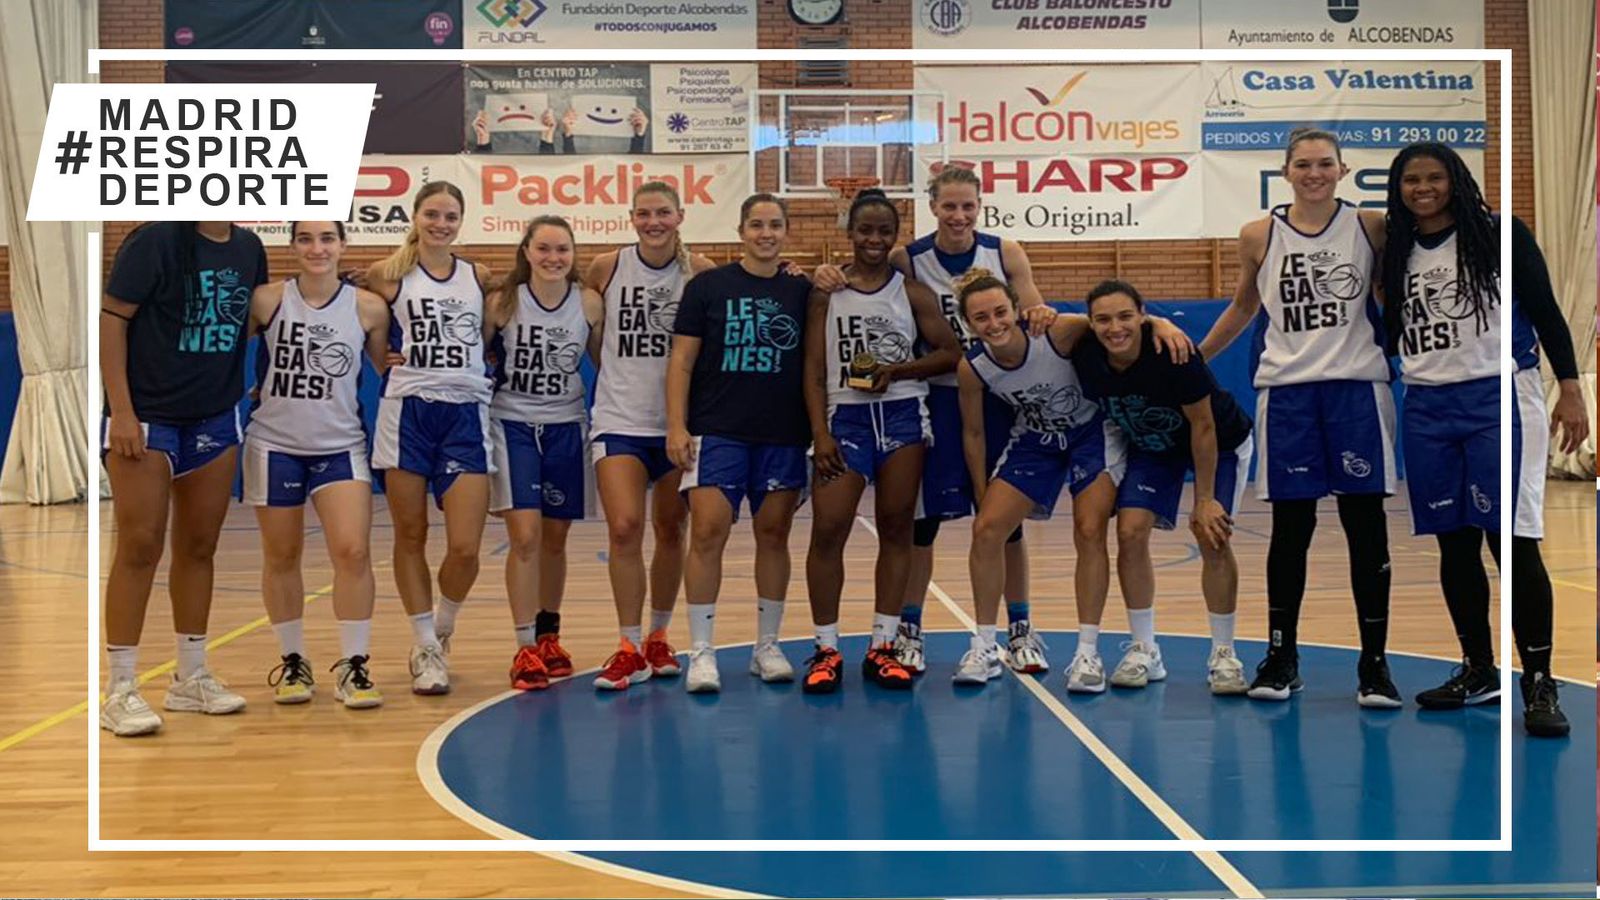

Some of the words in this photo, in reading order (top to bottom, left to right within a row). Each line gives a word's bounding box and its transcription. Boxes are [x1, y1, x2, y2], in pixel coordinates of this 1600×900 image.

[562, 3, 624, 15] Fundación
[625, 3, 677, 17] Deporte
[678, 3, 748, 15] Alcobendas
[992, 0, 1039, 10] CLUB
[1045, 0, 1172, 9] BALONCESTO
[1016, 15, 1148, 30] ALCOBENDAS
[478, 31, 546, 44] FUNDAL
[1228, 29, 1315, 46] Ayuntamiento
[1320, 29, 1335, 43] de
[1347, 27, 1454, 44] ALCOBENDAS
[518, 68, 531, 78] En
[533, 67, 577, 78] CENTRO
[579, 67, 598, 78] TAP
[1242, 70, 1316, 91] Casa
[1324, 69, 1474, 91] Valentina
[470, 80, 490, 89] nos
[493, 80, 523, 91] gusta
[561, 79, 576, 89] de
[1205, 131, 1271, 145] PEDIDOS
[1274, 131, 1285, 143] Y
[1371, 127, 1392, 142] 91
[1398, 127, 1432, 142] 293
[1437, 127, 1459, 143] 00
[1464, 127, 1486, 143] 22
[983, 205, 1015, 228] Be
[1025, 203, 1139, 235] Original.
[1280, 252, 1307, 278] LE
[620, 286, 645, 308] LE
[1279, 280, 1316, 304] GA
[407, 298, 435, 321] LE
[618, 309, 647, 331] GA
[726, 297, 753, 321] LE
[277, 320, 306, 346] LE
[410, 321, 441, 344] GA
[516, 324, 544, 348] LE
[724, 321, 757, 346] GA
[836, 315, 862, 339] LE
[274, 346, 306, 373] GA
[514, 349, 545, 371] GA
